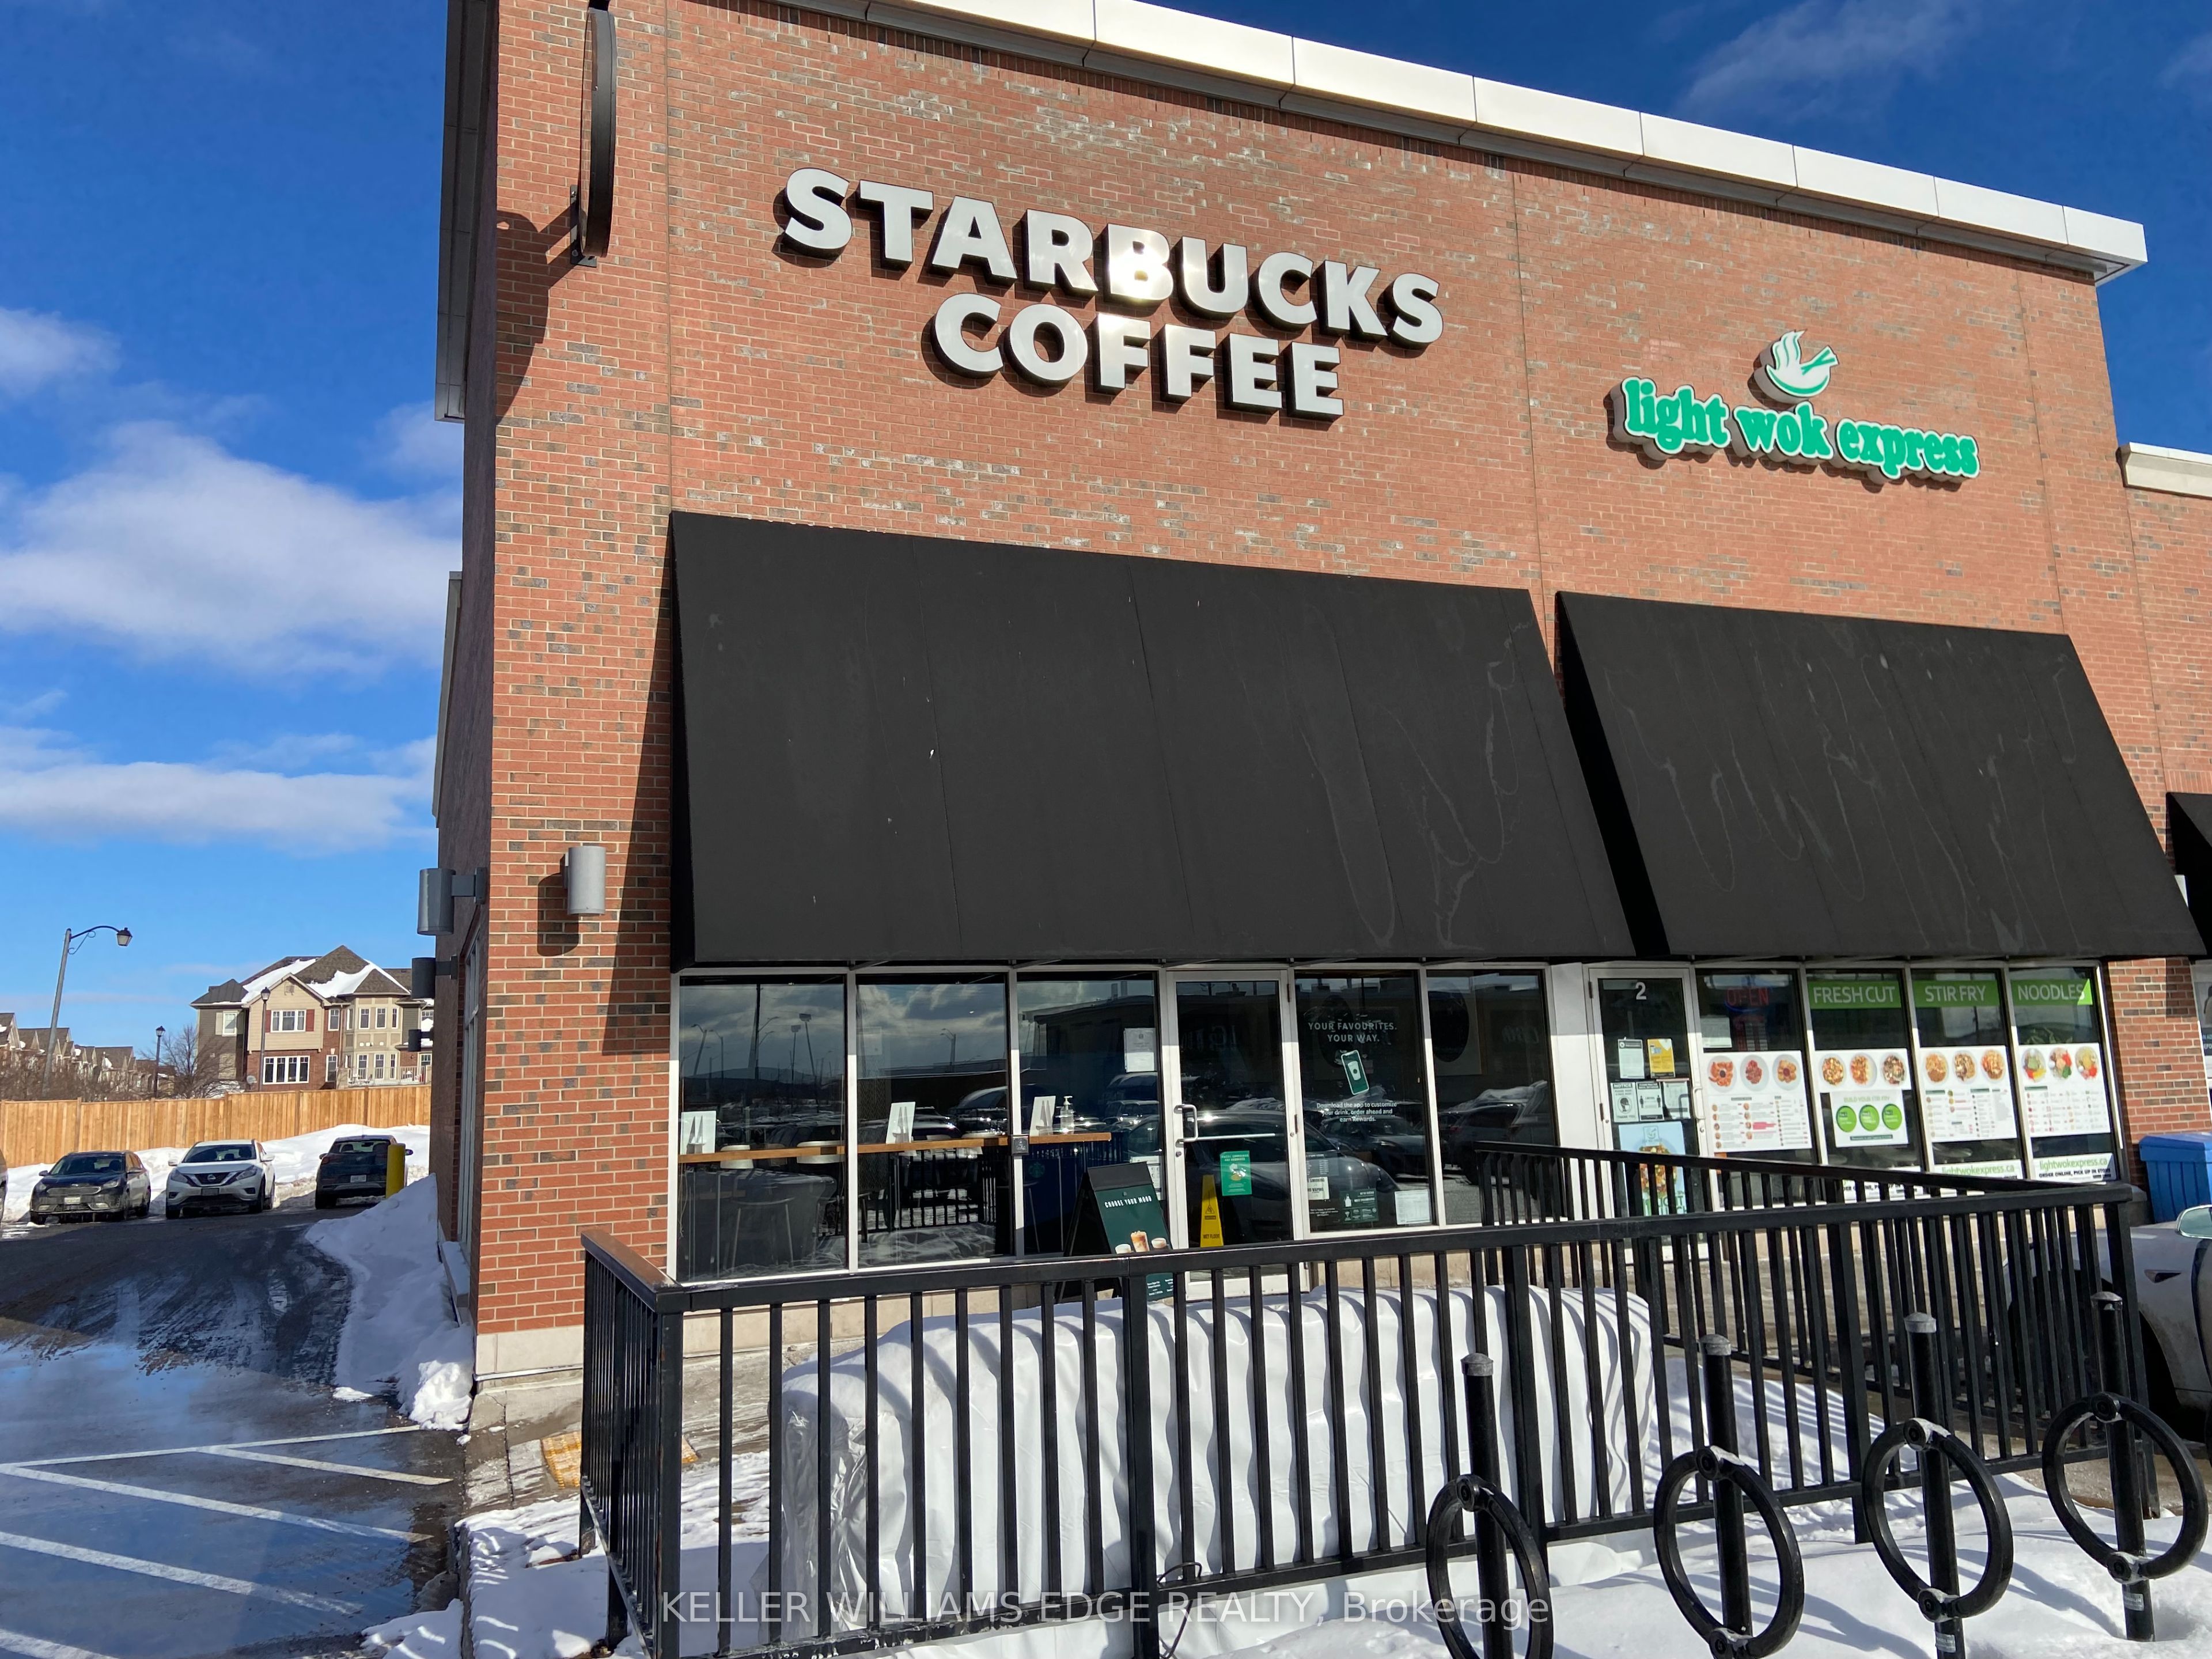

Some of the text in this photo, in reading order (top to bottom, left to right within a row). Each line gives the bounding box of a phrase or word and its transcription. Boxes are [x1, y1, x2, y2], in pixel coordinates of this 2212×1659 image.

[782, 167, 1444, 346] STARBUCKS
[930, 292, 1344, 422] COFFEE
[1622, 376, 1980, 479] light wok express
[1635, 982, 1647, 1000] 2
[1726, 987, 1770, 1006] OPEN
[1813, 986, 1895, 1004] FRESH CUT
[1925, 985, 1986, 1002] STIR FRY
[2018, 984, 2085, 1001] NOODLES
[1308, 1022, 1397, 1030] YOUR FAVOURITES.
[1327, 1034, 1380, 1043] YOUR WAY.
[2039, 1158, 2108, 1171] lightwokexpress.ca
[1104, 1199, 1124, 1208] CHOOSE
[1138, 1195, 1152, 1203] MOOD
